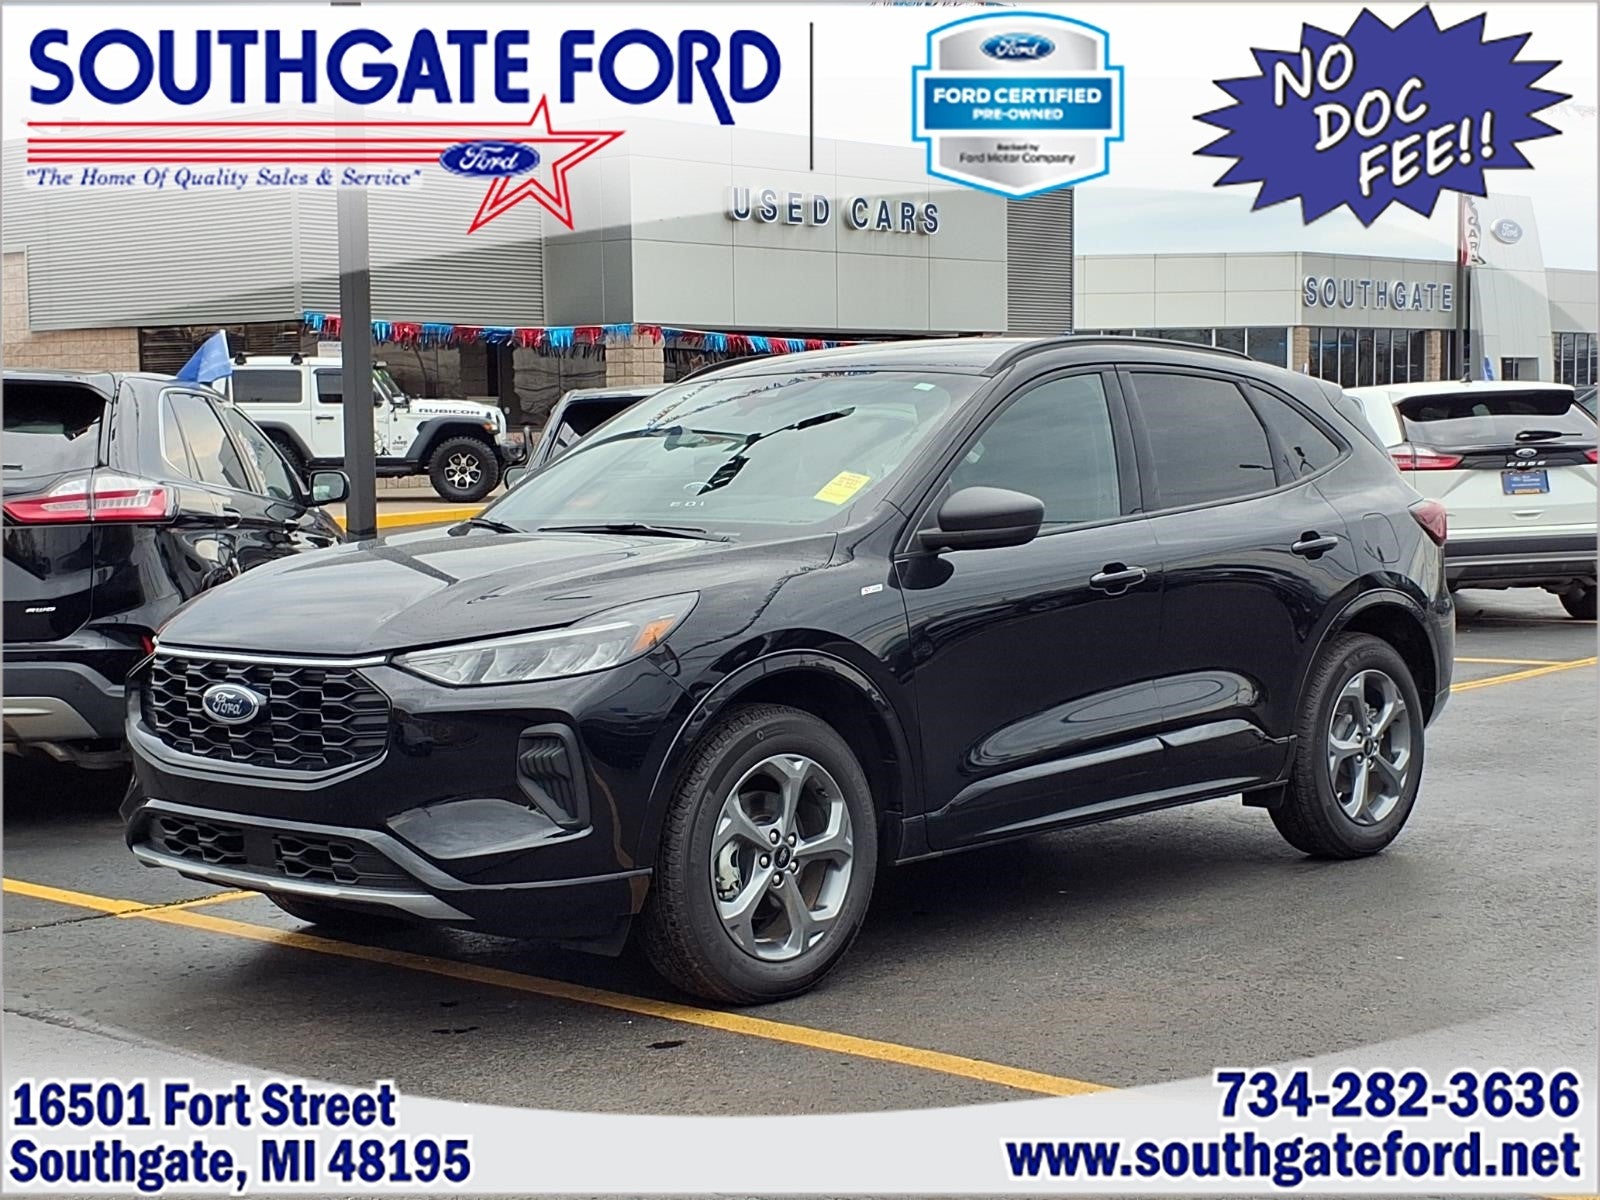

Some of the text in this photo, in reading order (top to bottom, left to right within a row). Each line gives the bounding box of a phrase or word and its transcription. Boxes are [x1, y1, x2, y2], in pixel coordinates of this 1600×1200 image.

[732, 186, 939, 234] USED CARS
[1304, 276, 1453, 311] SOUTHGATE
